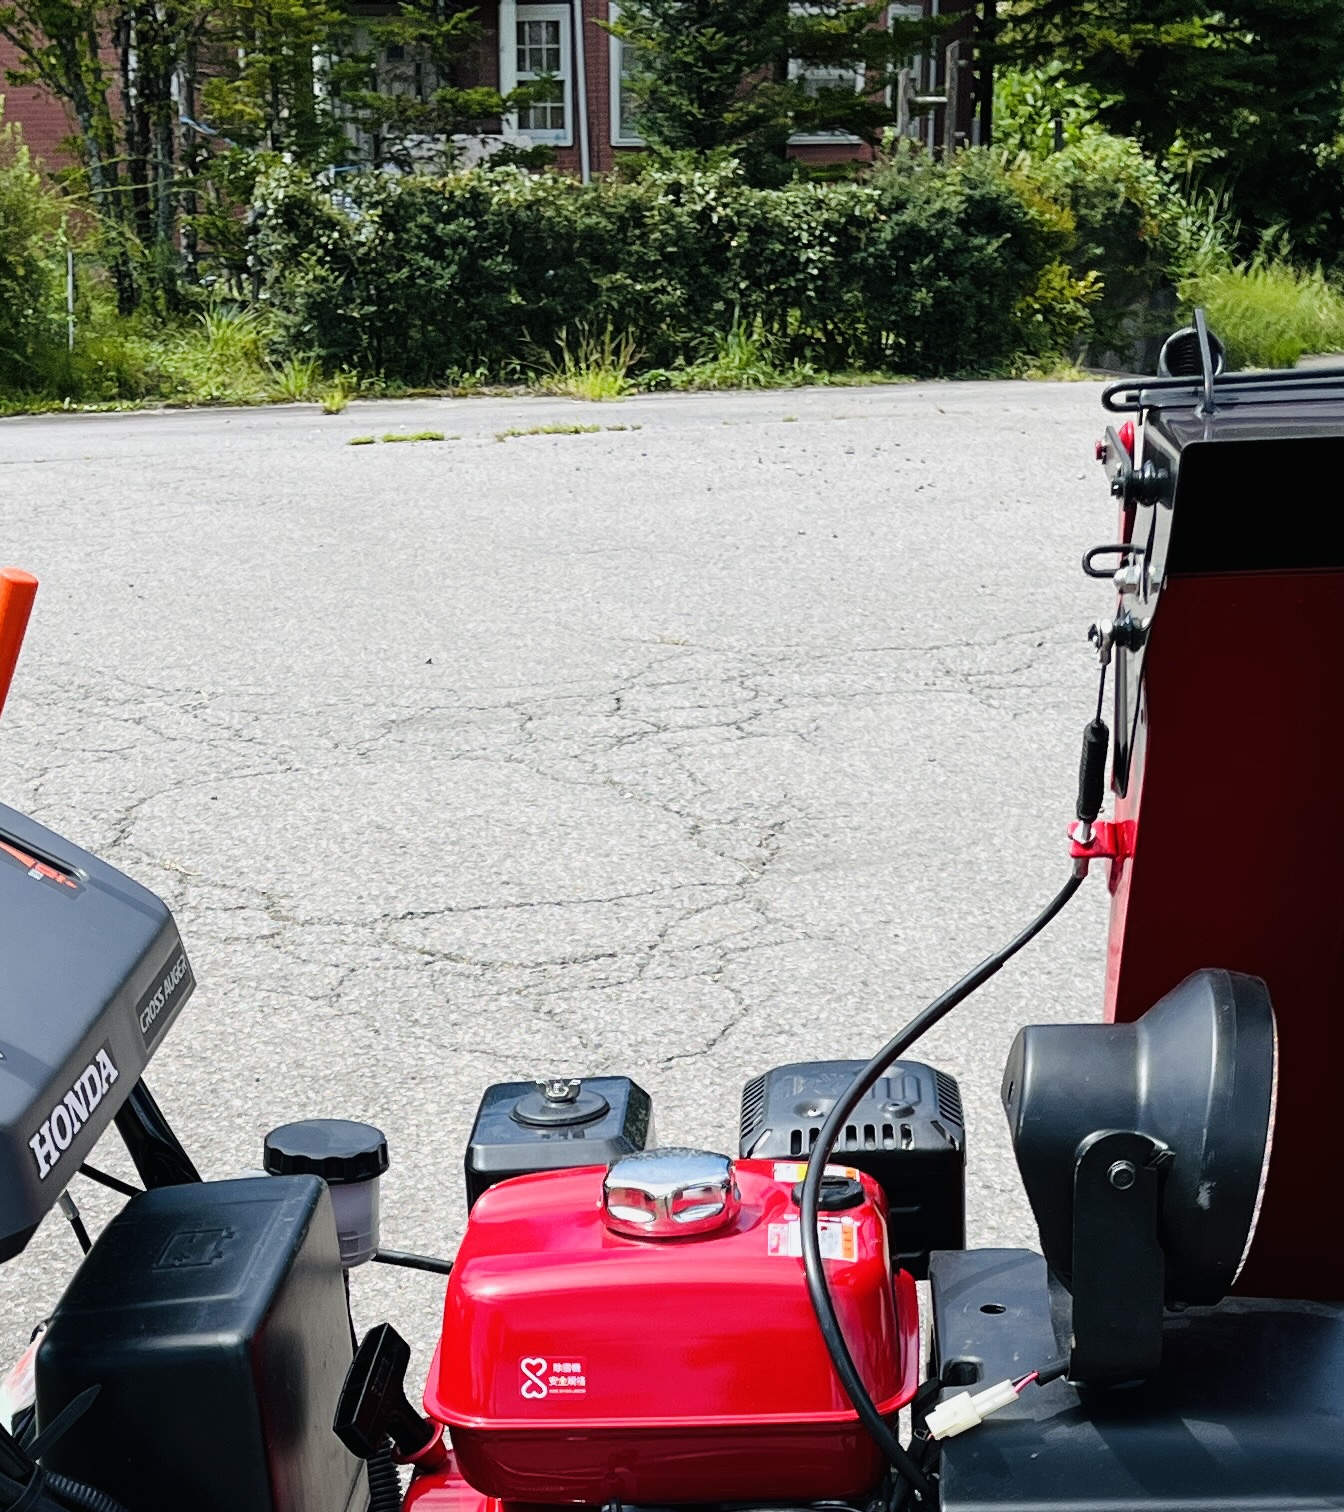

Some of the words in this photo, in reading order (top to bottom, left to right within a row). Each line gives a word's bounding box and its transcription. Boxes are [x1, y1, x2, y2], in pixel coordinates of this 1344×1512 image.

[139, 985, 165, 1034] CROSS
[163, 954, 188, 1001] AUGER
[28, 1048, 119, 1180] HONDA
